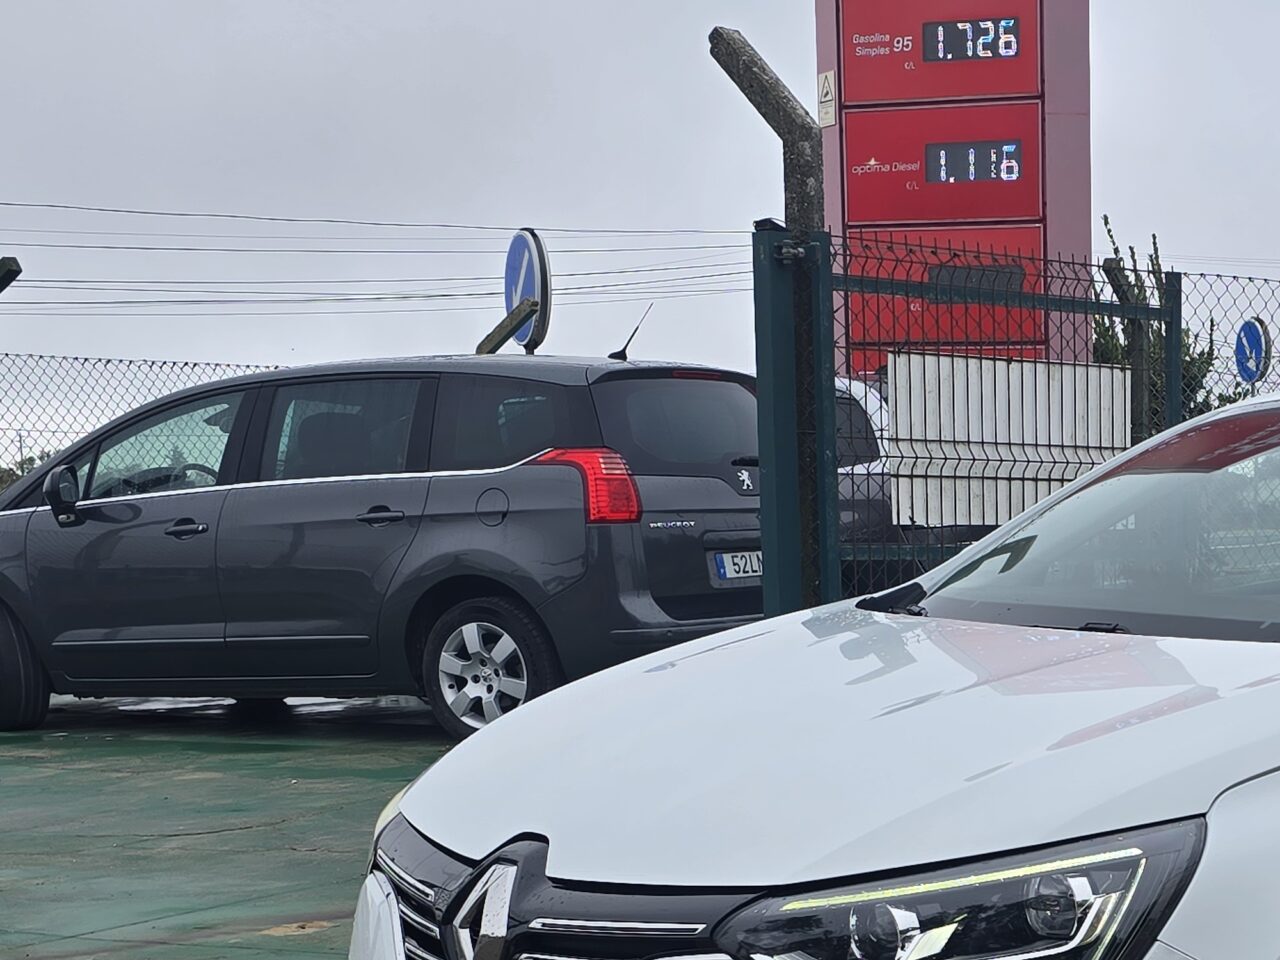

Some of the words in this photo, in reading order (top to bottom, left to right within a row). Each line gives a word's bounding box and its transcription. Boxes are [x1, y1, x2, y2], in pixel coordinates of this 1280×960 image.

[852, 33, 890, 43] Gasolina
[937, 19, 1017, 59] 1.726
[893, 36, 913, 52] 95
[855, 46, 890, 57] Simples
[892, 160, 920, 171] Diesel
